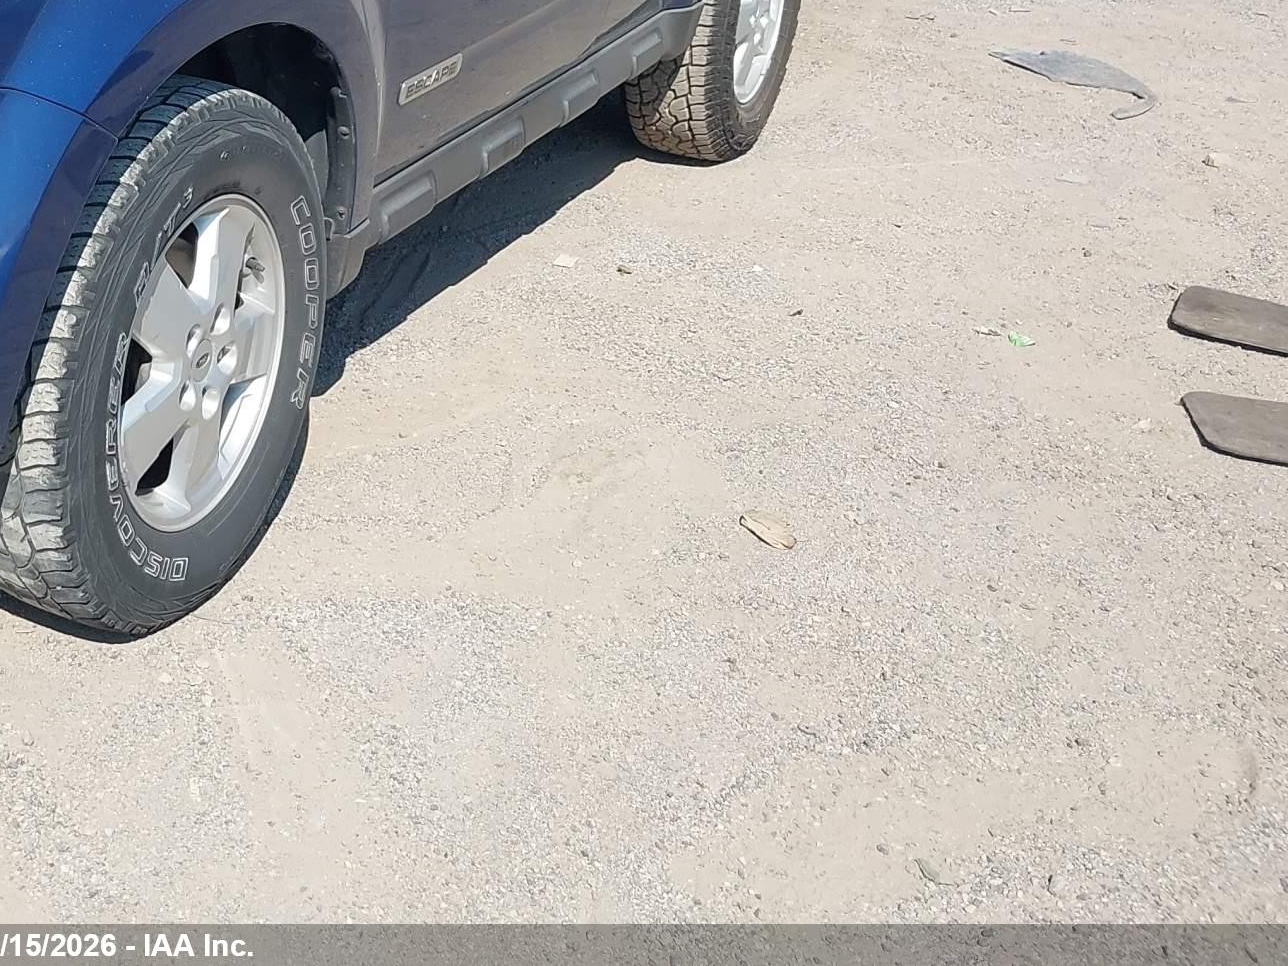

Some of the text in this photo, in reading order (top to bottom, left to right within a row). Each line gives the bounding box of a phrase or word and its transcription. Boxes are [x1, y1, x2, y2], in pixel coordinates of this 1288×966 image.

[404, 60, 458, 99] ESCAPE
[290, 194, 321, 411] COOPER
[105, 331, 190, 583] DISCOVERER
